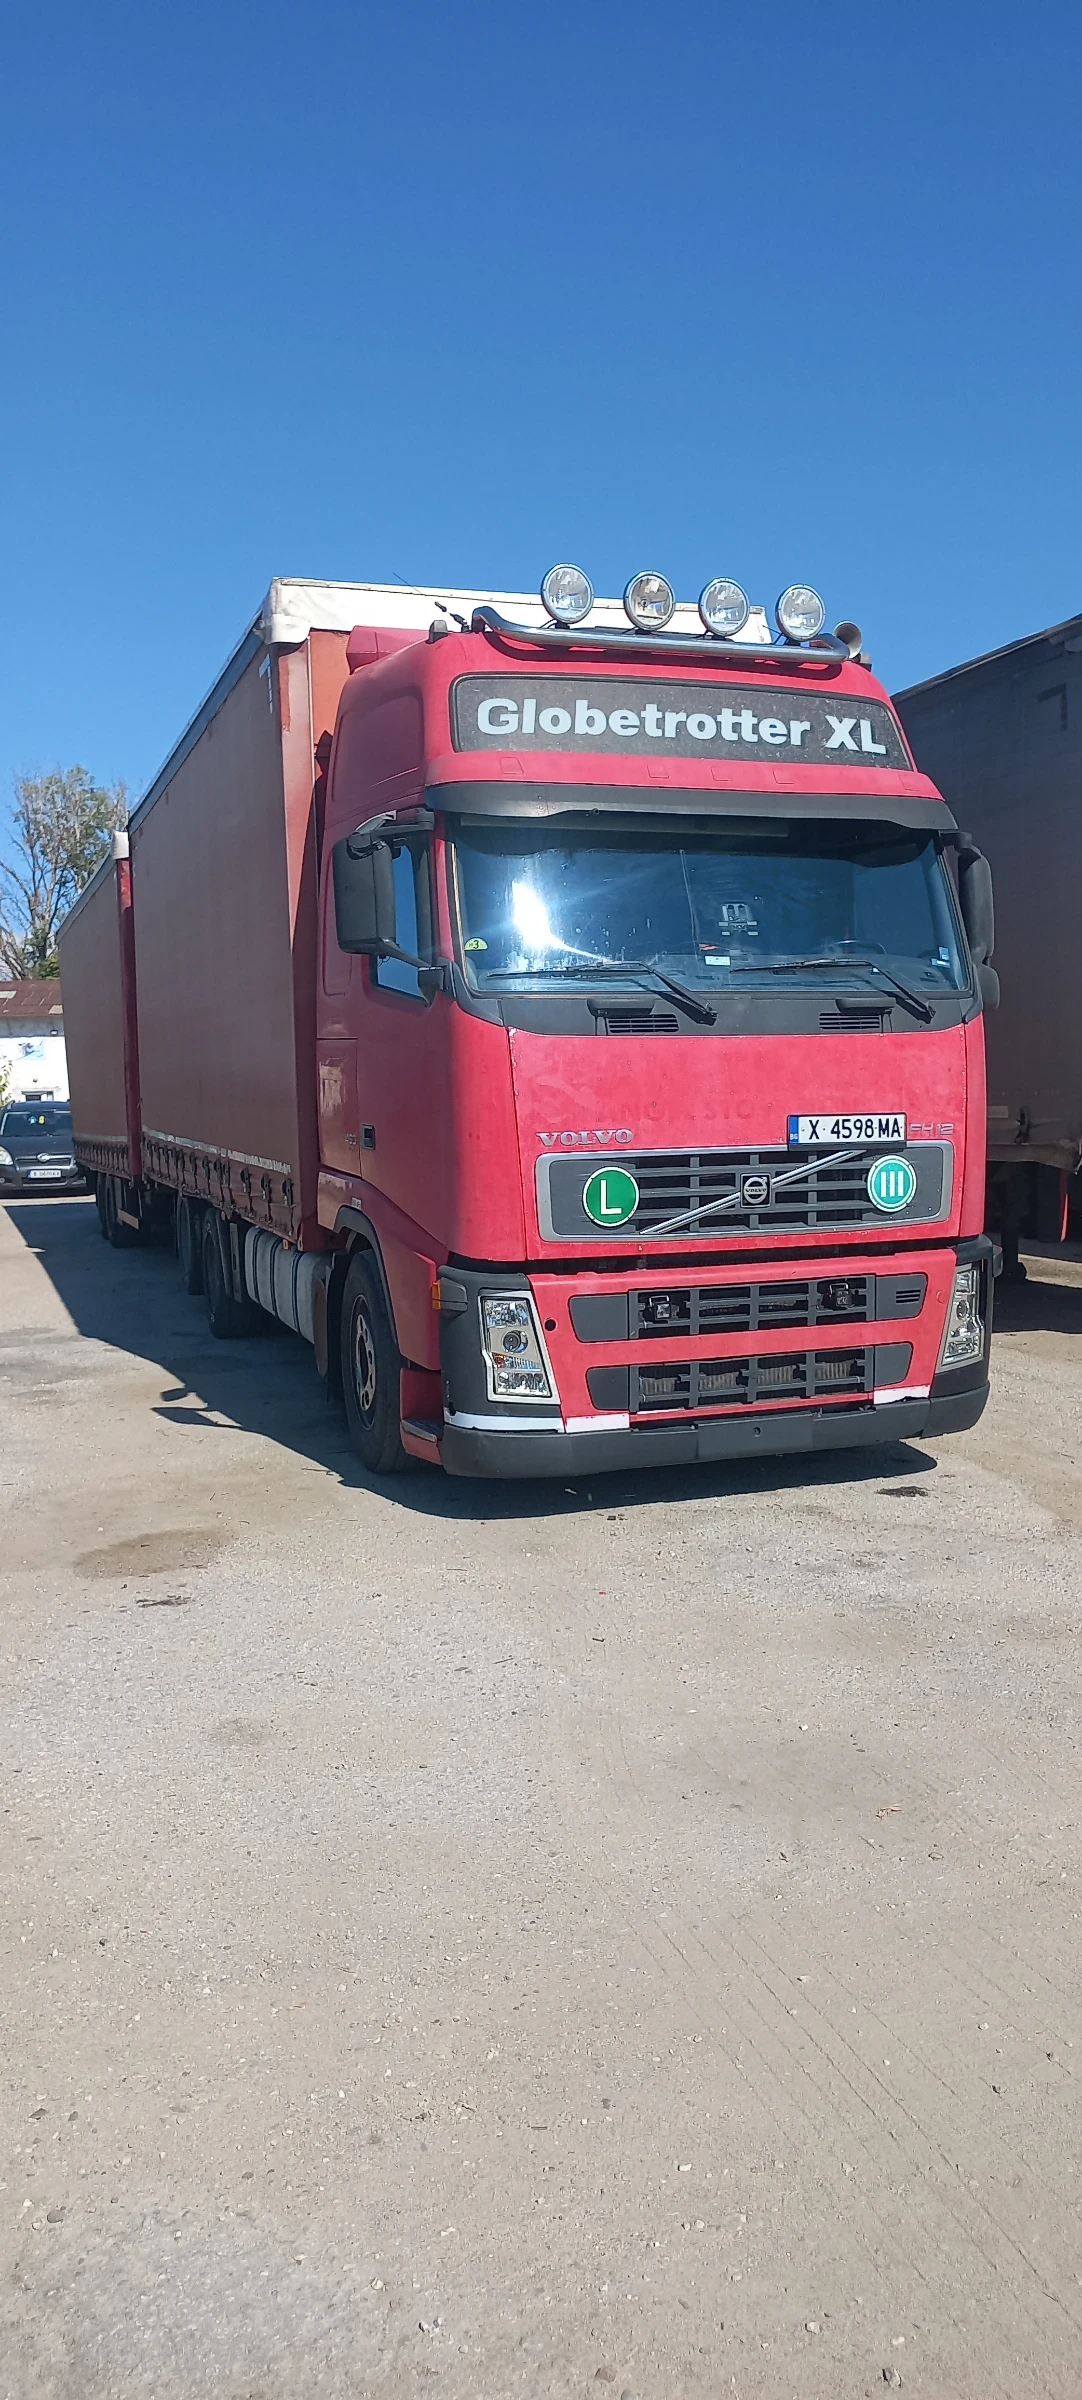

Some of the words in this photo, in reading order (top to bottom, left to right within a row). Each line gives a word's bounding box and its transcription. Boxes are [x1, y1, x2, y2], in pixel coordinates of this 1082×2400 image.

[476, 698, 811, 746] Globetrotter
[824, 714, 887, 755] XL
[536, 1128, 634, 1147] VOLVO
[809, 1119, 819, 1140] X
[831, 1118, 874, 1139] 4598
[878, 1117, 901, 1138] MA
[600, 1179, 622, 1215] L
